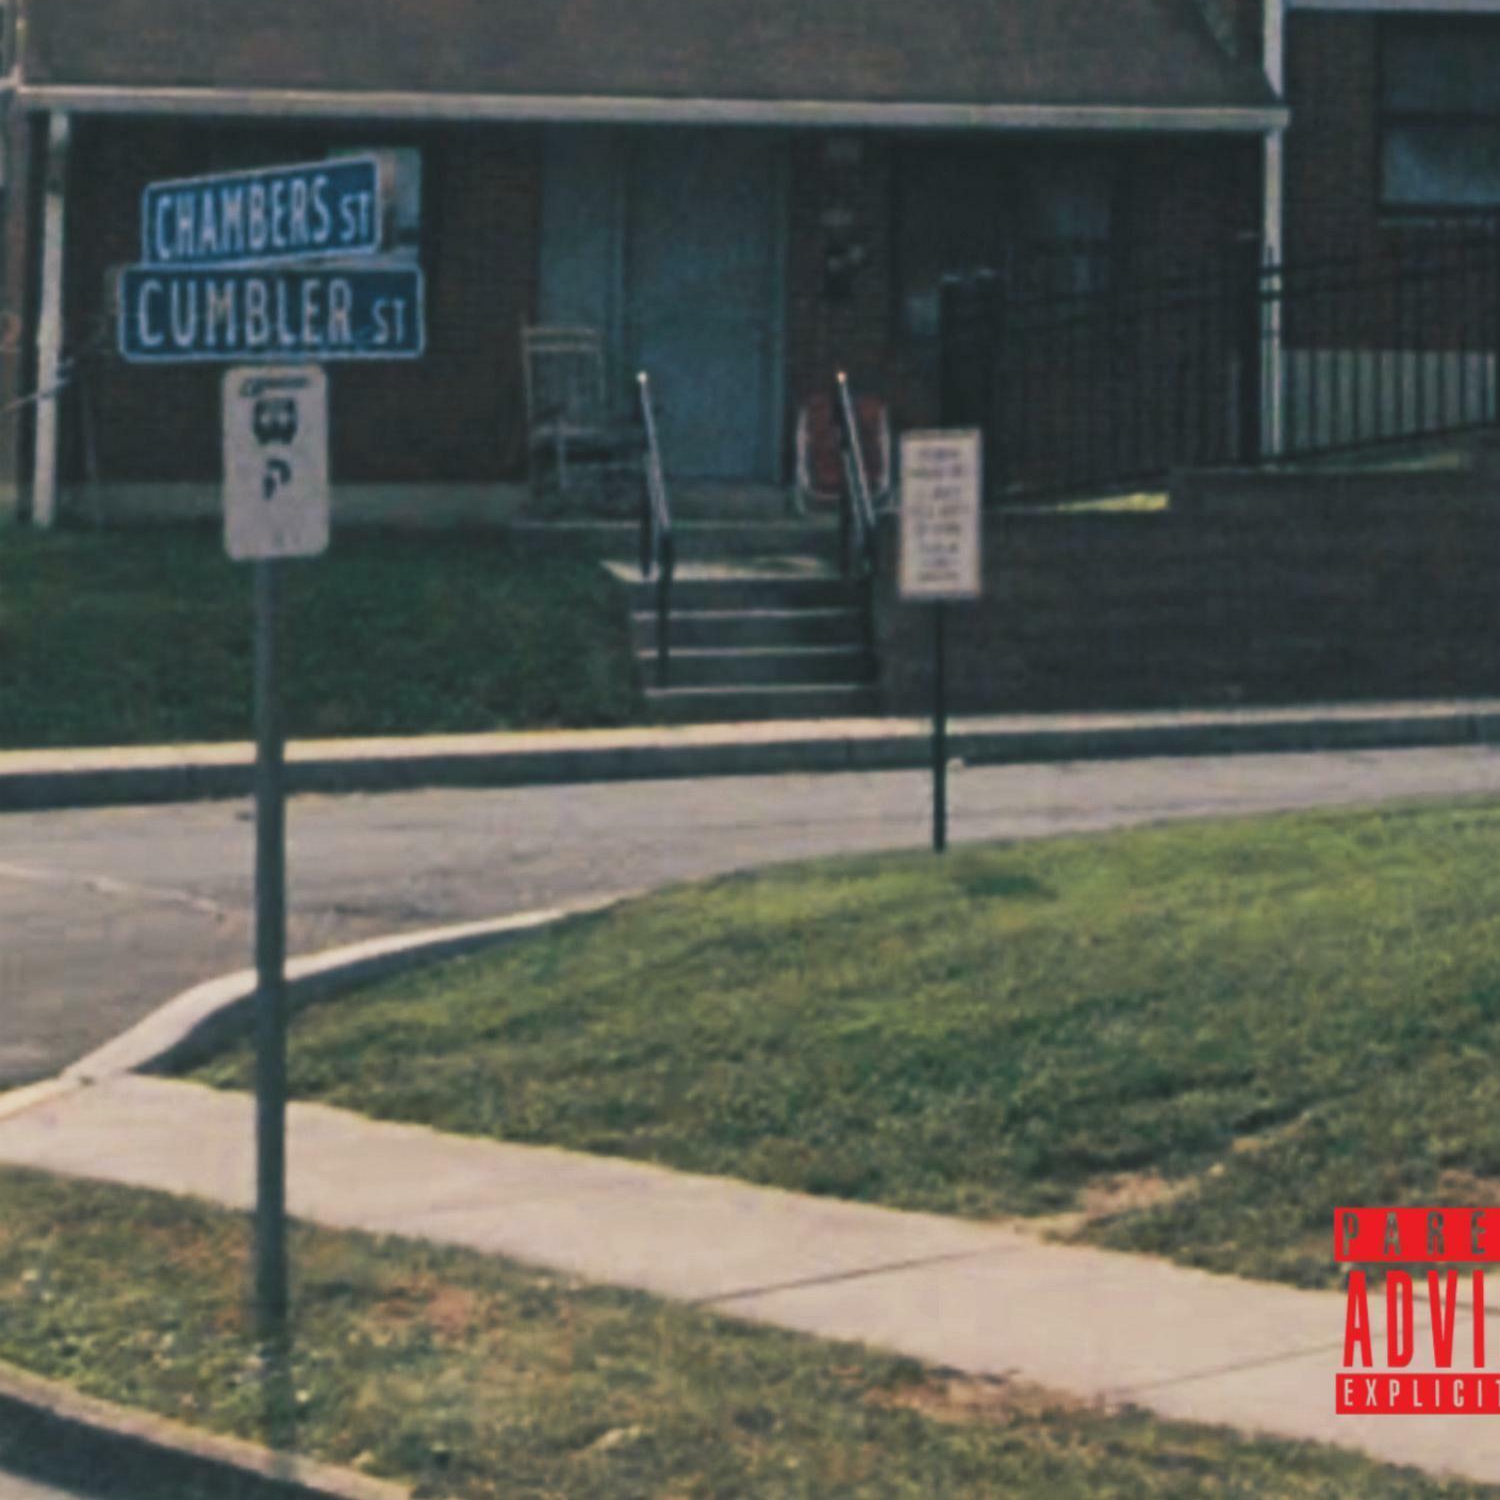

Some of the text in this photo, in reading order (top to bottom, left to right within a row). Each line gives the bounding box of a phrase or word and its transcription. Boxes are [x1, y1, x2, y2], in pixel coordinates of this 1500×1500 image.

[156, 175, 371, 259] CHAMBERS ST
[137, 279, 406, 347] CUMBLER ST
